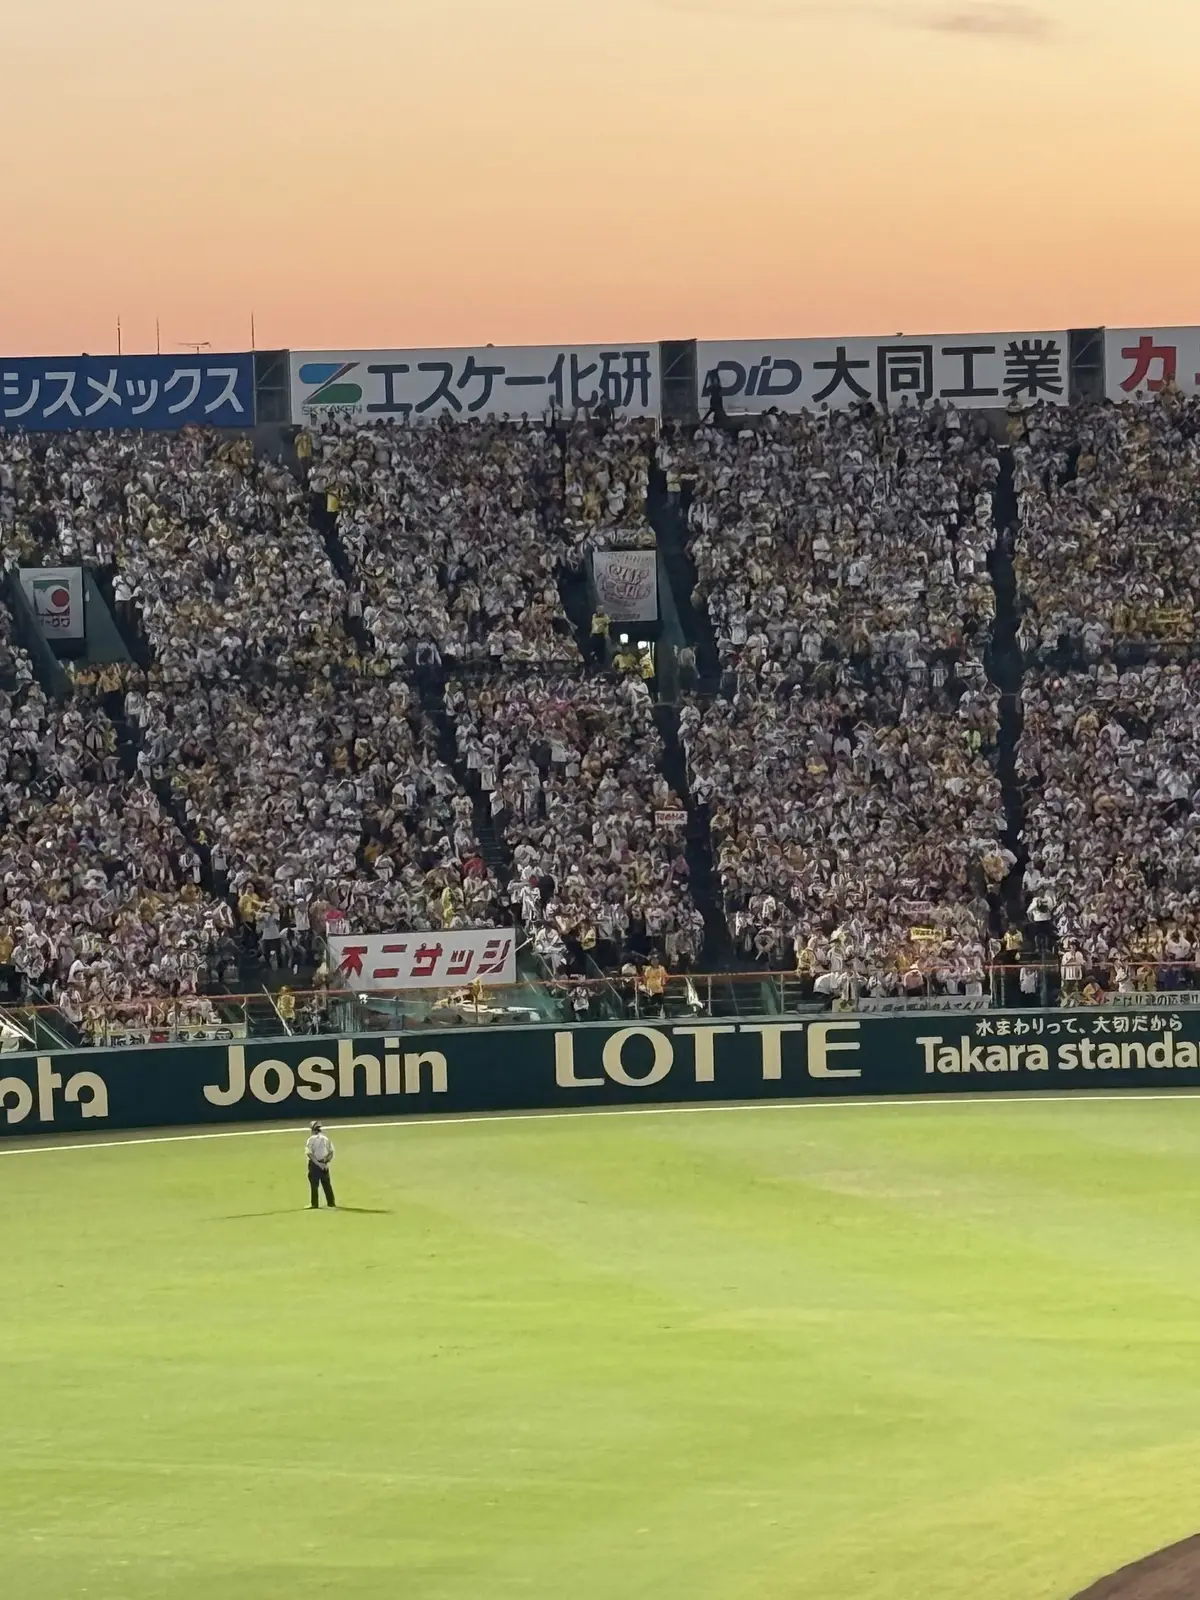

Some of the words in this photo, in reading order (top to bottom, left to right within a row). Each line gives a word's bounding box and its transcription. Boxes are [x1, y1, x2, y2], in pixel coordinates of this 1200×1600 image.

[3, 367, 245, 418] シスメックス
[367, 352, 652, 413] エスケー化研
[811, 339, 1063, 403] 大同工業
[1120, 336, 1200, 394] カ
[334, 939, 512, 979] 不二サッシ
[915, 1035, 1049, 1074] Takara
[1057, 1031, 1200, 1071] standa
[975, 1013, 1183, 1036] 水まわりって、大切だから
[203, 1037, 448, 1106] Joshin
[554, 1021, 862, 1087] LOTTE
